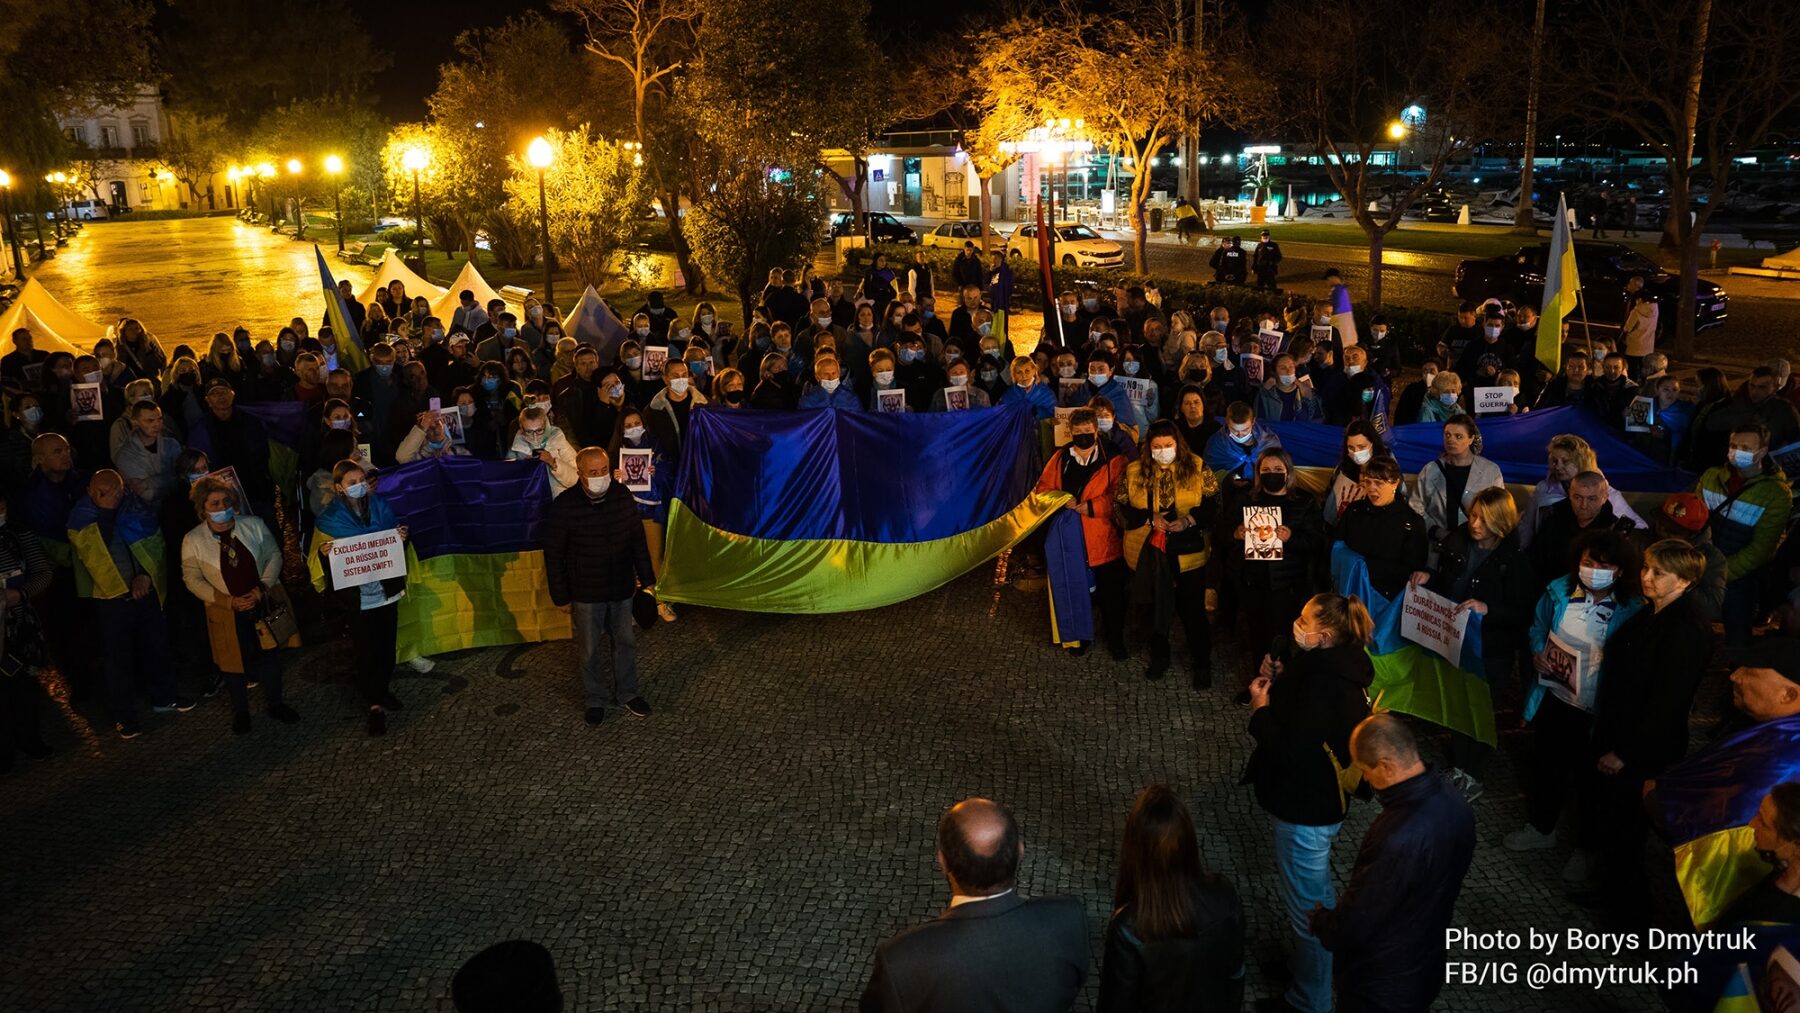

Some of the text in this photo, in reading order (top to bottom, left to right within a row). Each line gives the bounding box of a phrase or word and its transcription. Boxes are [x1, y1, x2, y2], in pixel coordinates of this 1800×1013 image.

[1127, 380, 1137, 390] NO
[333, 536, 397, 556] EXCLUSÃO IMEDIATA
[345, 549, 388, 565] DA RÚSSIA DO
[343, 560, 394, 577] SISTEMA SWIFT!
[1413, 594, 1433, 610] DURAS
[1416, 622, 1421, 632] A
